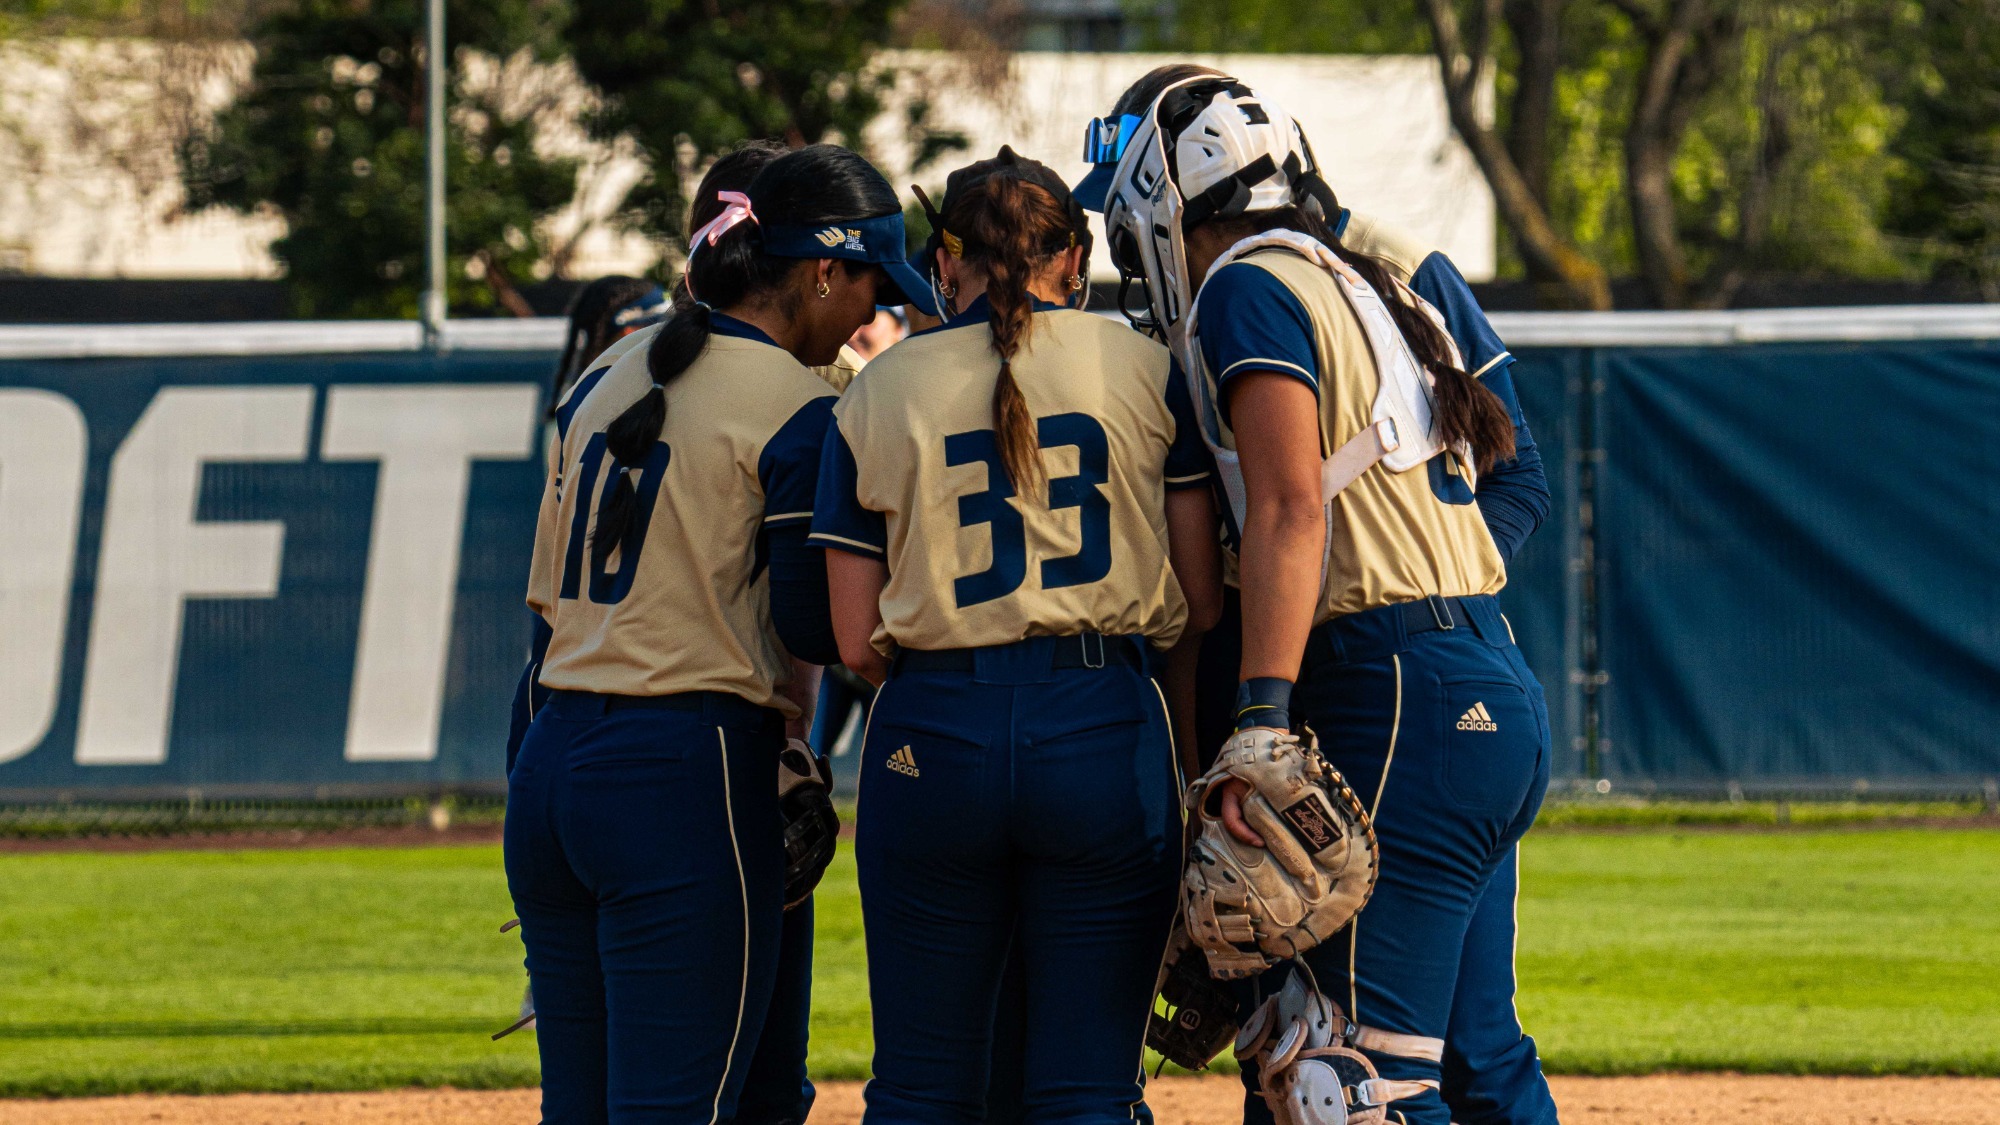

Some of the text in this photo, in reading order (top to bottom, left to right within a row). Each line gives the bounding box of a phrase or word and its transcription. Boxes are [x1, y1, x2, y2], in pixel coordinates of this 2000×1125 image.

[846, 228, 862, 238] THE
[559, 432, 671, 605] 10
[944, 411, 1113, 609] 33
[1456, 718, 1498, 732] adidas
[886, 759, 920, 778] adidas
